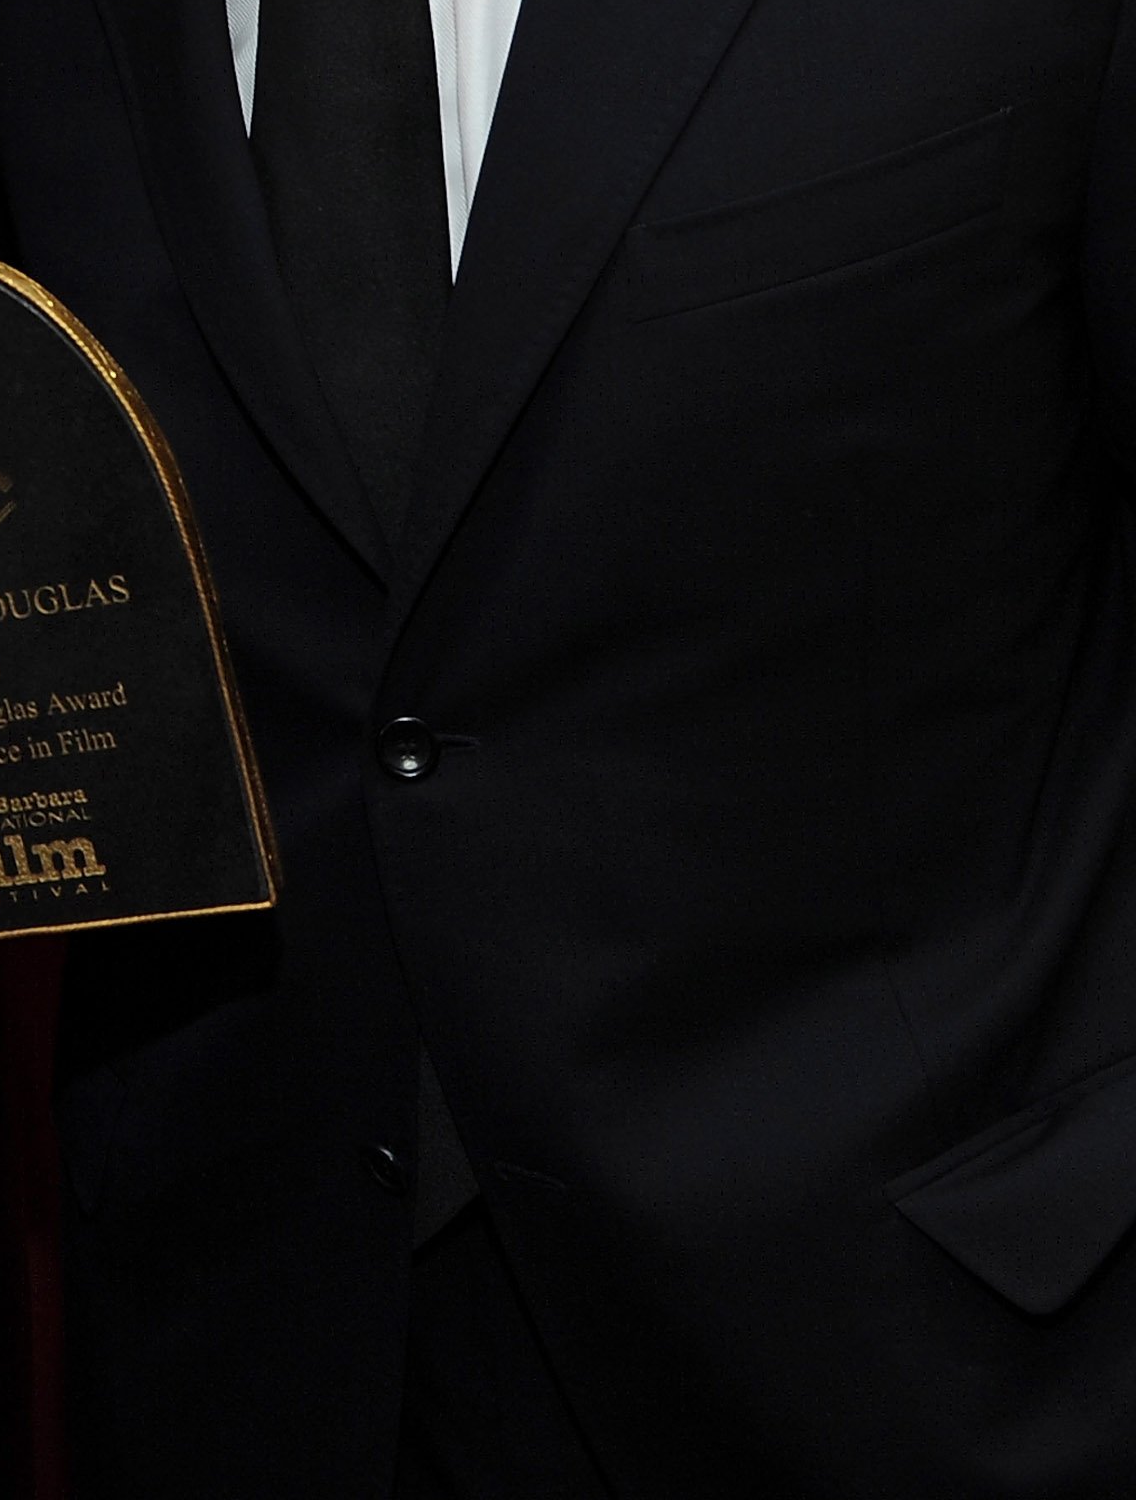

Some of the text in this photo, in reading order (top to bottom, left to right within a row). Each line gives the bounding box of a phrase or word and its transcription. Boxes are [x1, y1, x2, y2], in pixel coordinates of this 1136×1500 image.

[47, 682, 128, 717] Award
[27, 736, 53, 760] in
[59, 728, 117, 755] Film
